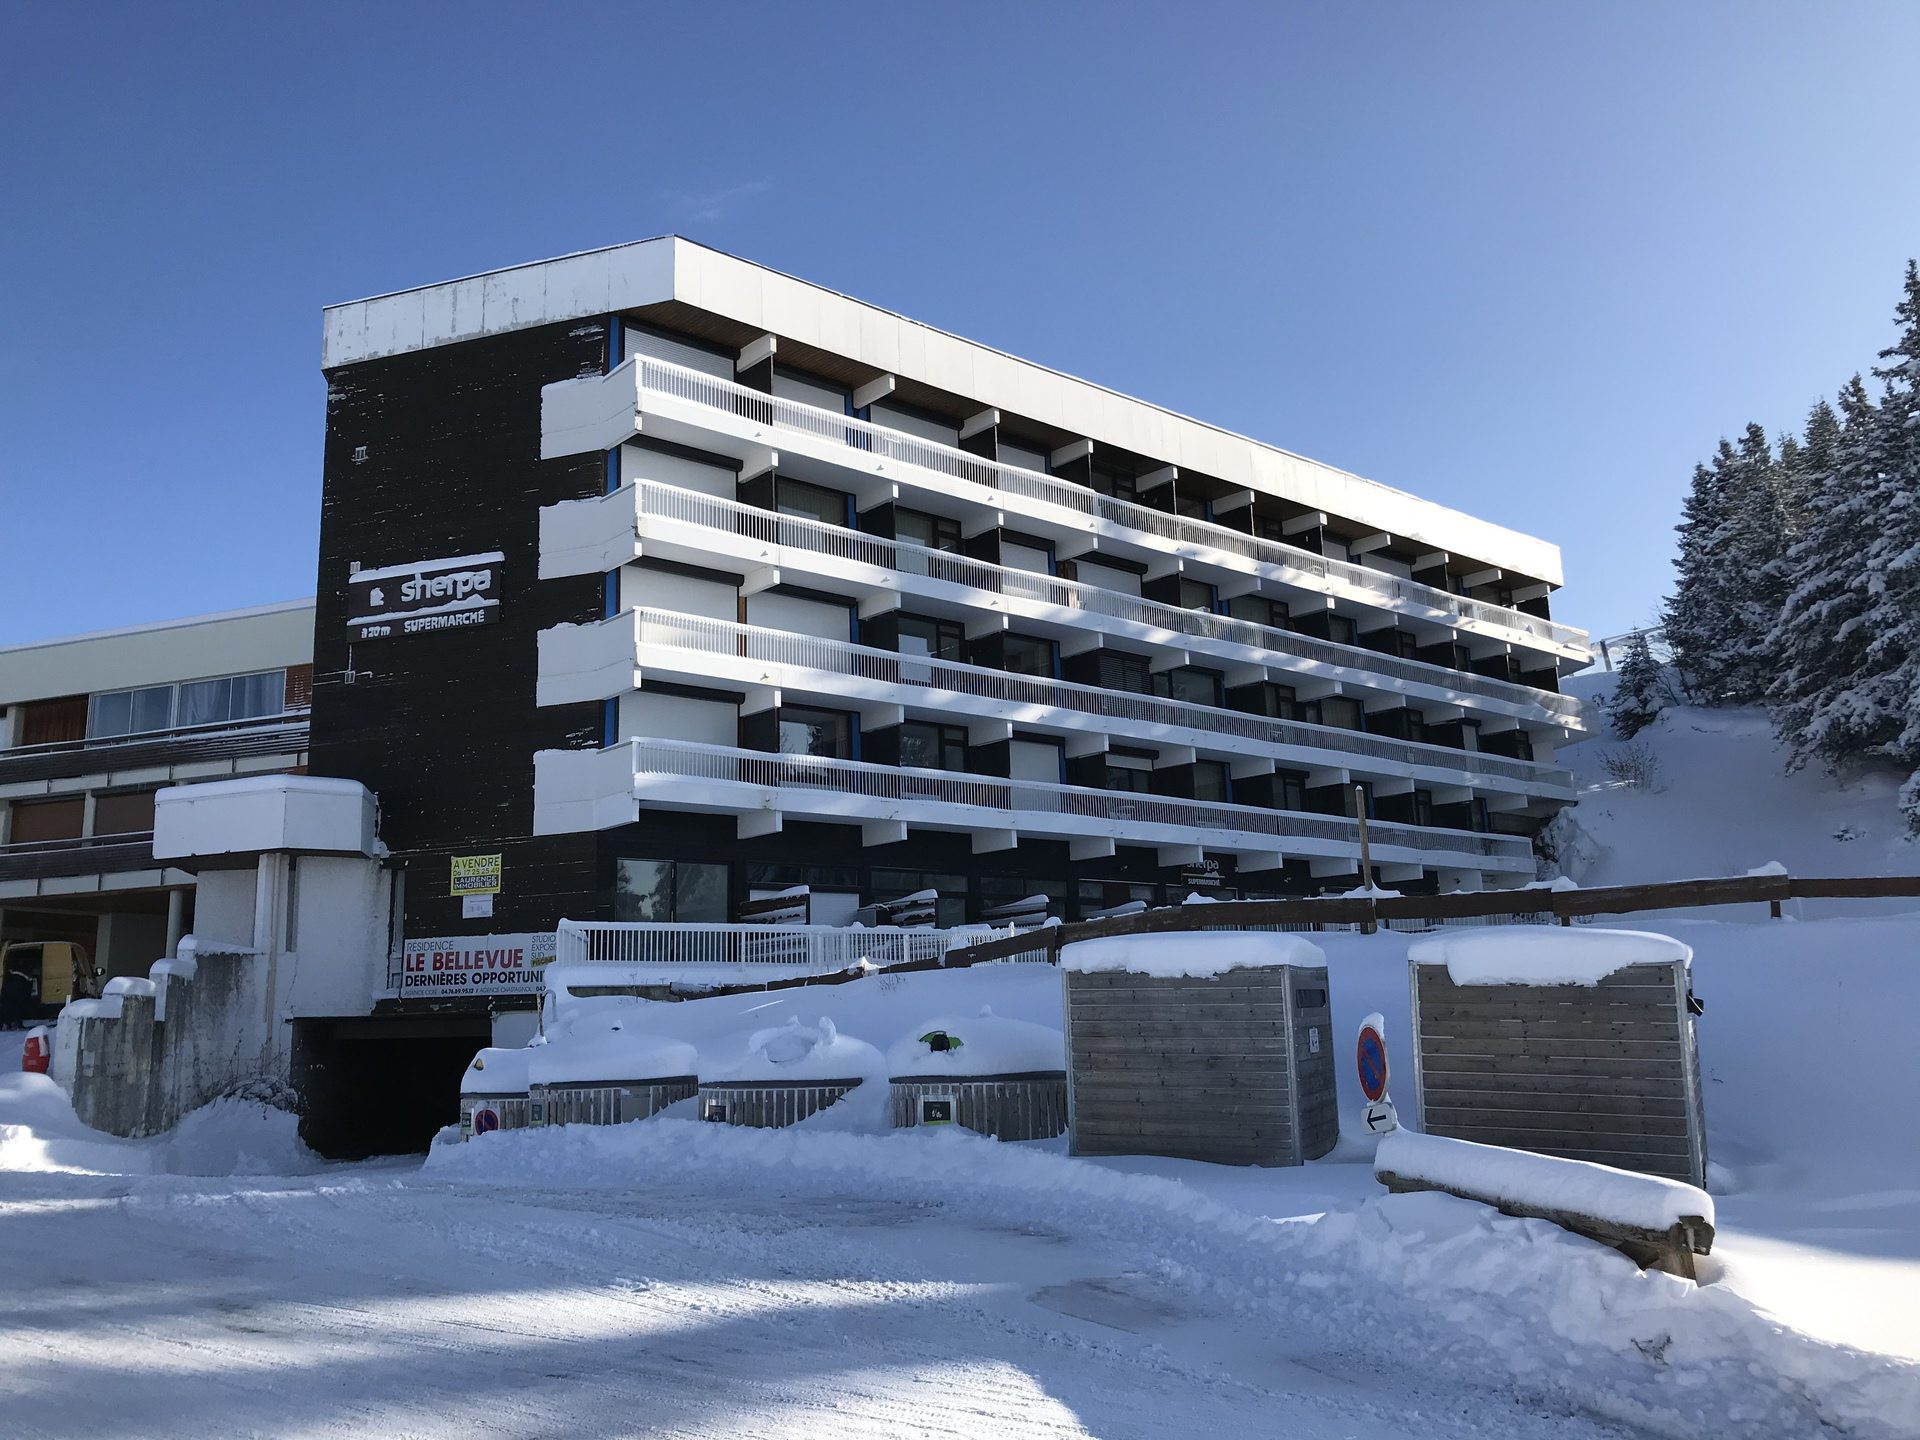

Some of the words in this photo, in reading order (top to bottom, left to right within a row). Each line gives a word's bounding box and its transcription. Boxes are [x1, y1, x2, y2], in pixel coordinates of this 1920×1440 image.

[401, 569, 491, 602] sherpa
[462, 857, 499, 868] VENDRE
[454, 875, 497, 884] LAURENCE
[454, 881, 497, 889] IMMOBILIER
[407, 941, 454, 951] RÉSIDENCE
[406, 953, 425, 972] LE
[432, 949, 523, 971] BELLEVUE
[405, 972, 467, 987] DERNIÈRES
[472, 971, 545, 985] OPPORTUNI
